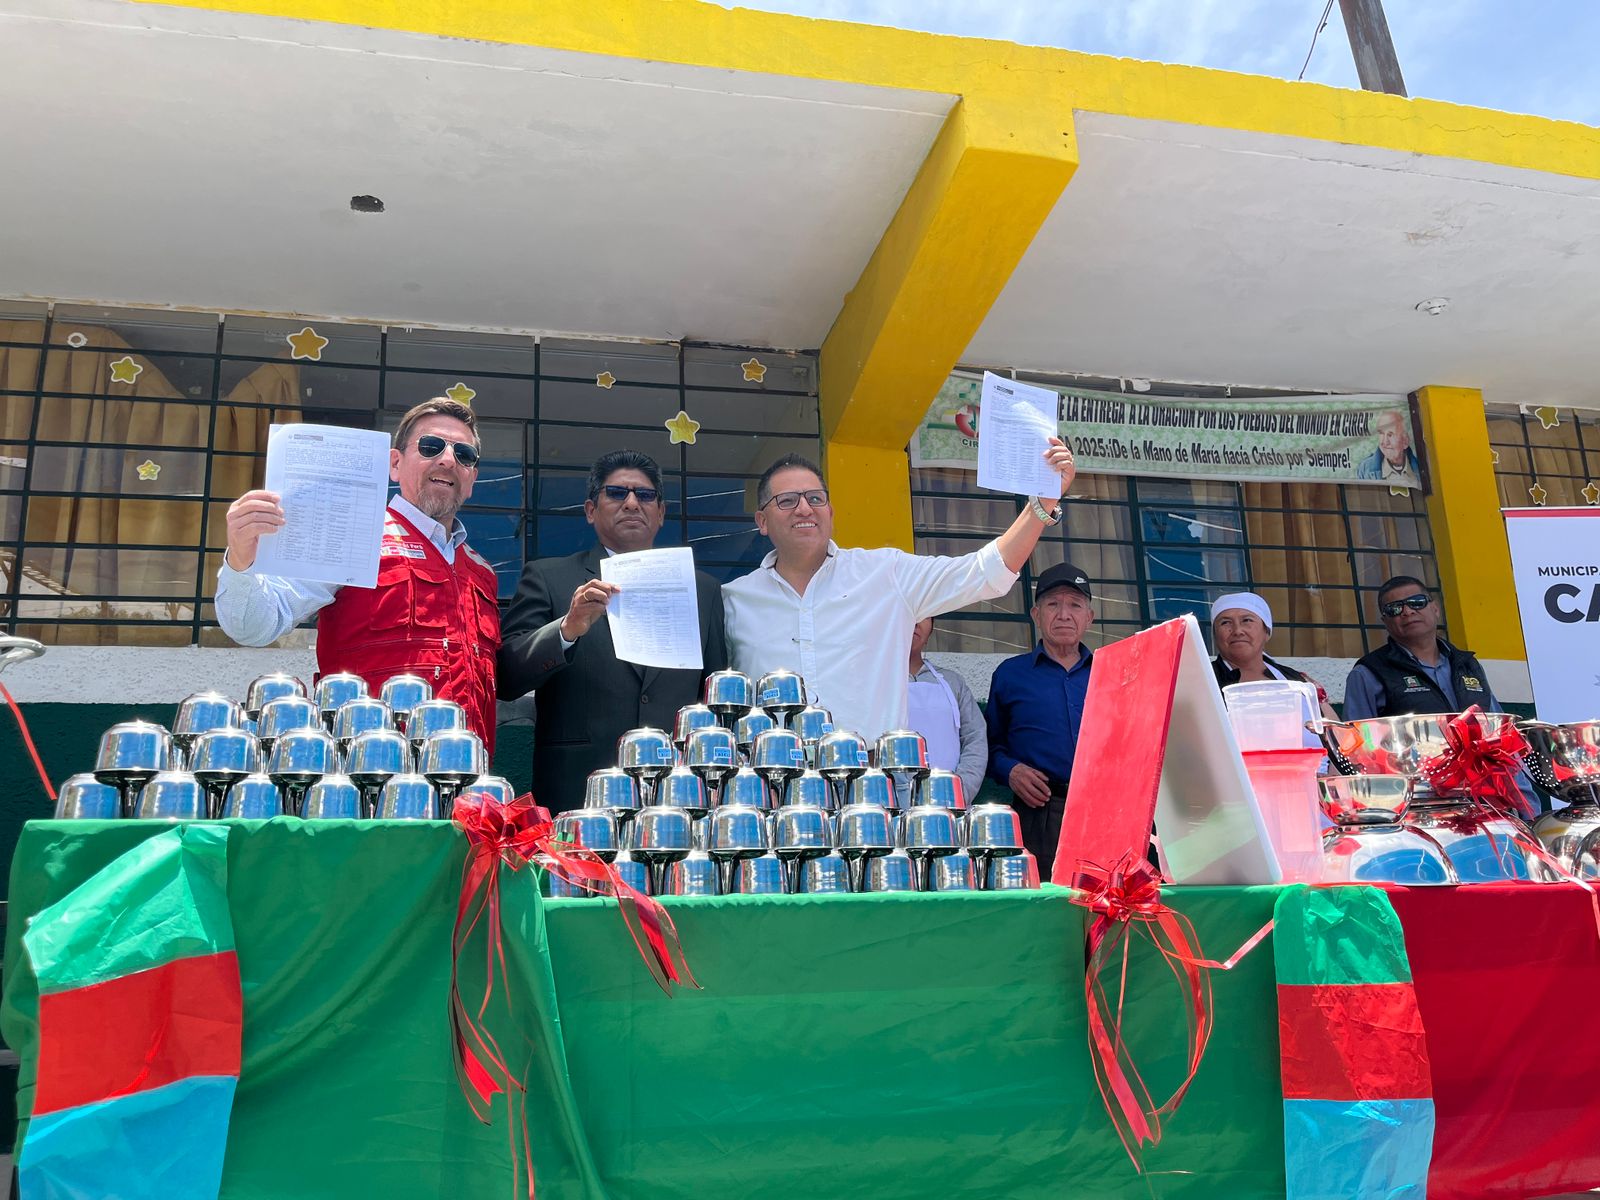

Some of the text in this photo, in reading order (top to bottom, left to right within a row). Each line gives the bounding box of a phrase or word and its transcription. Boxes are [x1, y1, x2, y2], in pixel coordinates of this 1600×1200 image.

[1057, 393, 1065, 421] E
[1067, 396, 1078, 422] LA
[1081, 398, 1125, 425] ENTREGA
[1129, 404, 1137, 425] A
[1138, 404, 1149, 425] LA
[1197, 409, 1216, 429] POR
[1218, 411, 1235, 431] LOS
[1237, 412, 1277, 433] PUEBLOS
[1279, 414, 1295, 434] DEL
[1296, 414, 1329, 436] MUNDO
[1330, 414, 1341, 436] EN
[1131, 439, 1141, 461] la
[1144, 440, 1173, 462] Mano
[1175, 442, 1189, 463] de
[1191, 443, 1221, 464] María
[1223, 444, 1250, 465] hacia
[1252, 446, 1284, 466] Cristo
[1286, 452, 1303, 470] por
[1307, 448, 1351, 472] Siempre!
[1537, 566, 1600, 576] MUNICIP
